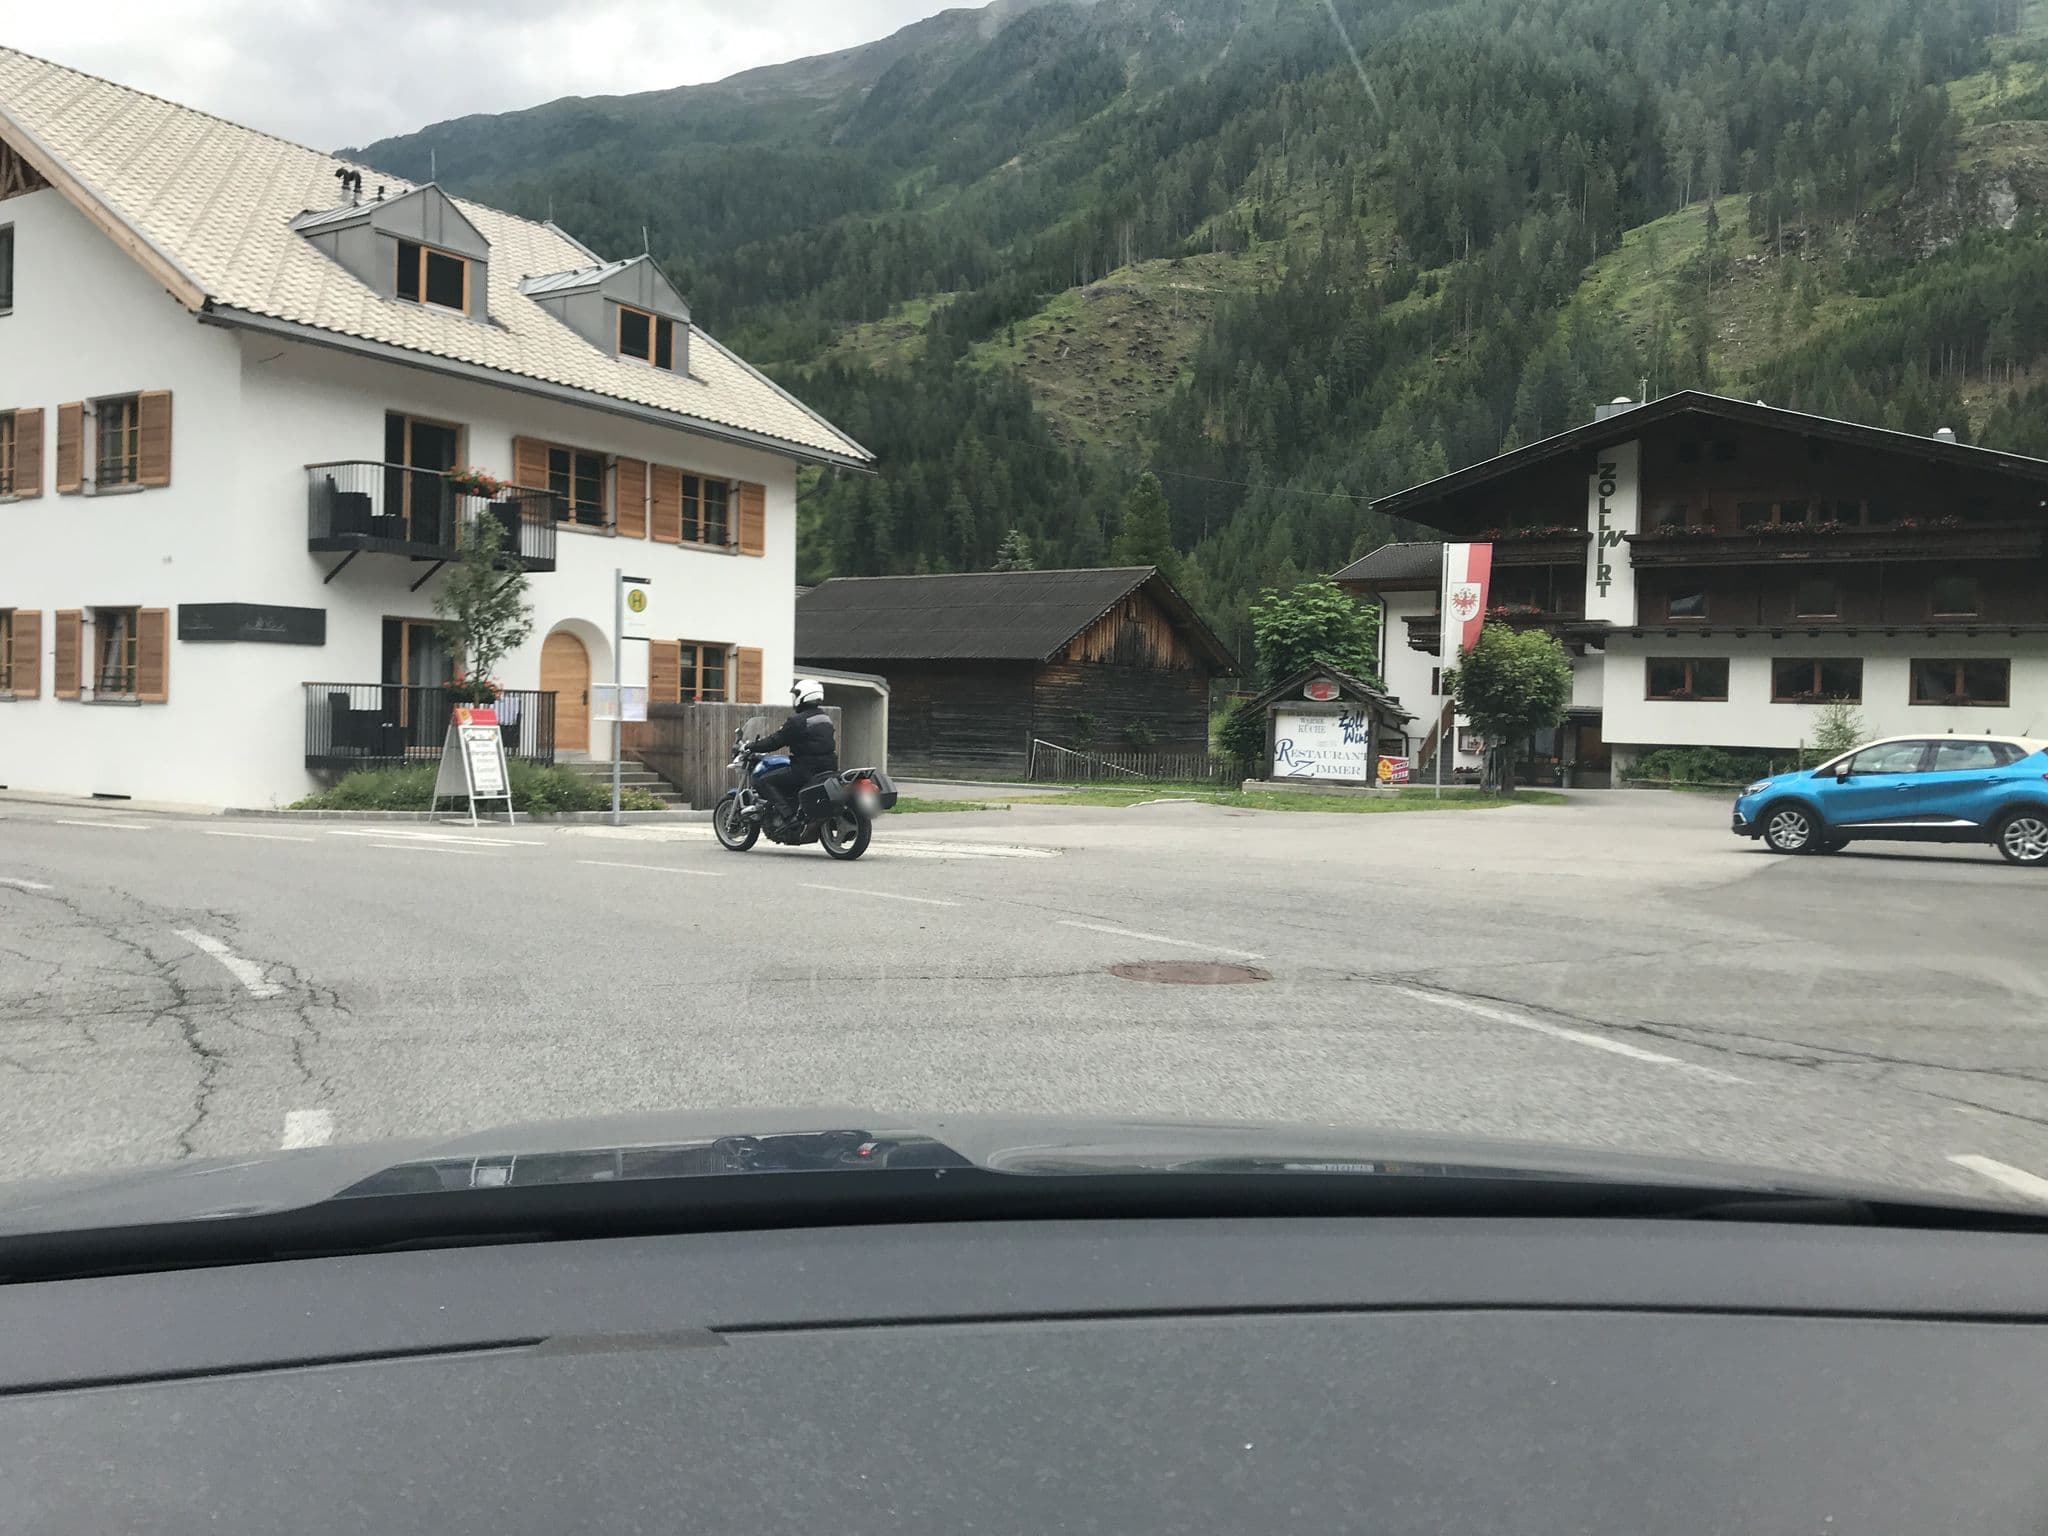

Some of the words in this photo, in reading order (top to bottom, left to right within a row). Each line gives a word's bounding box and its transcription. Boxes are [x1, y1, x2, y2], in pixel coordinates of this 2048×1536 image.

[1596, 462, 1627, 598] ZOLLWIRT
[1338, 709, 1364, 728] Zoll
[1288, 760, 1361, 777] ZIMMER
